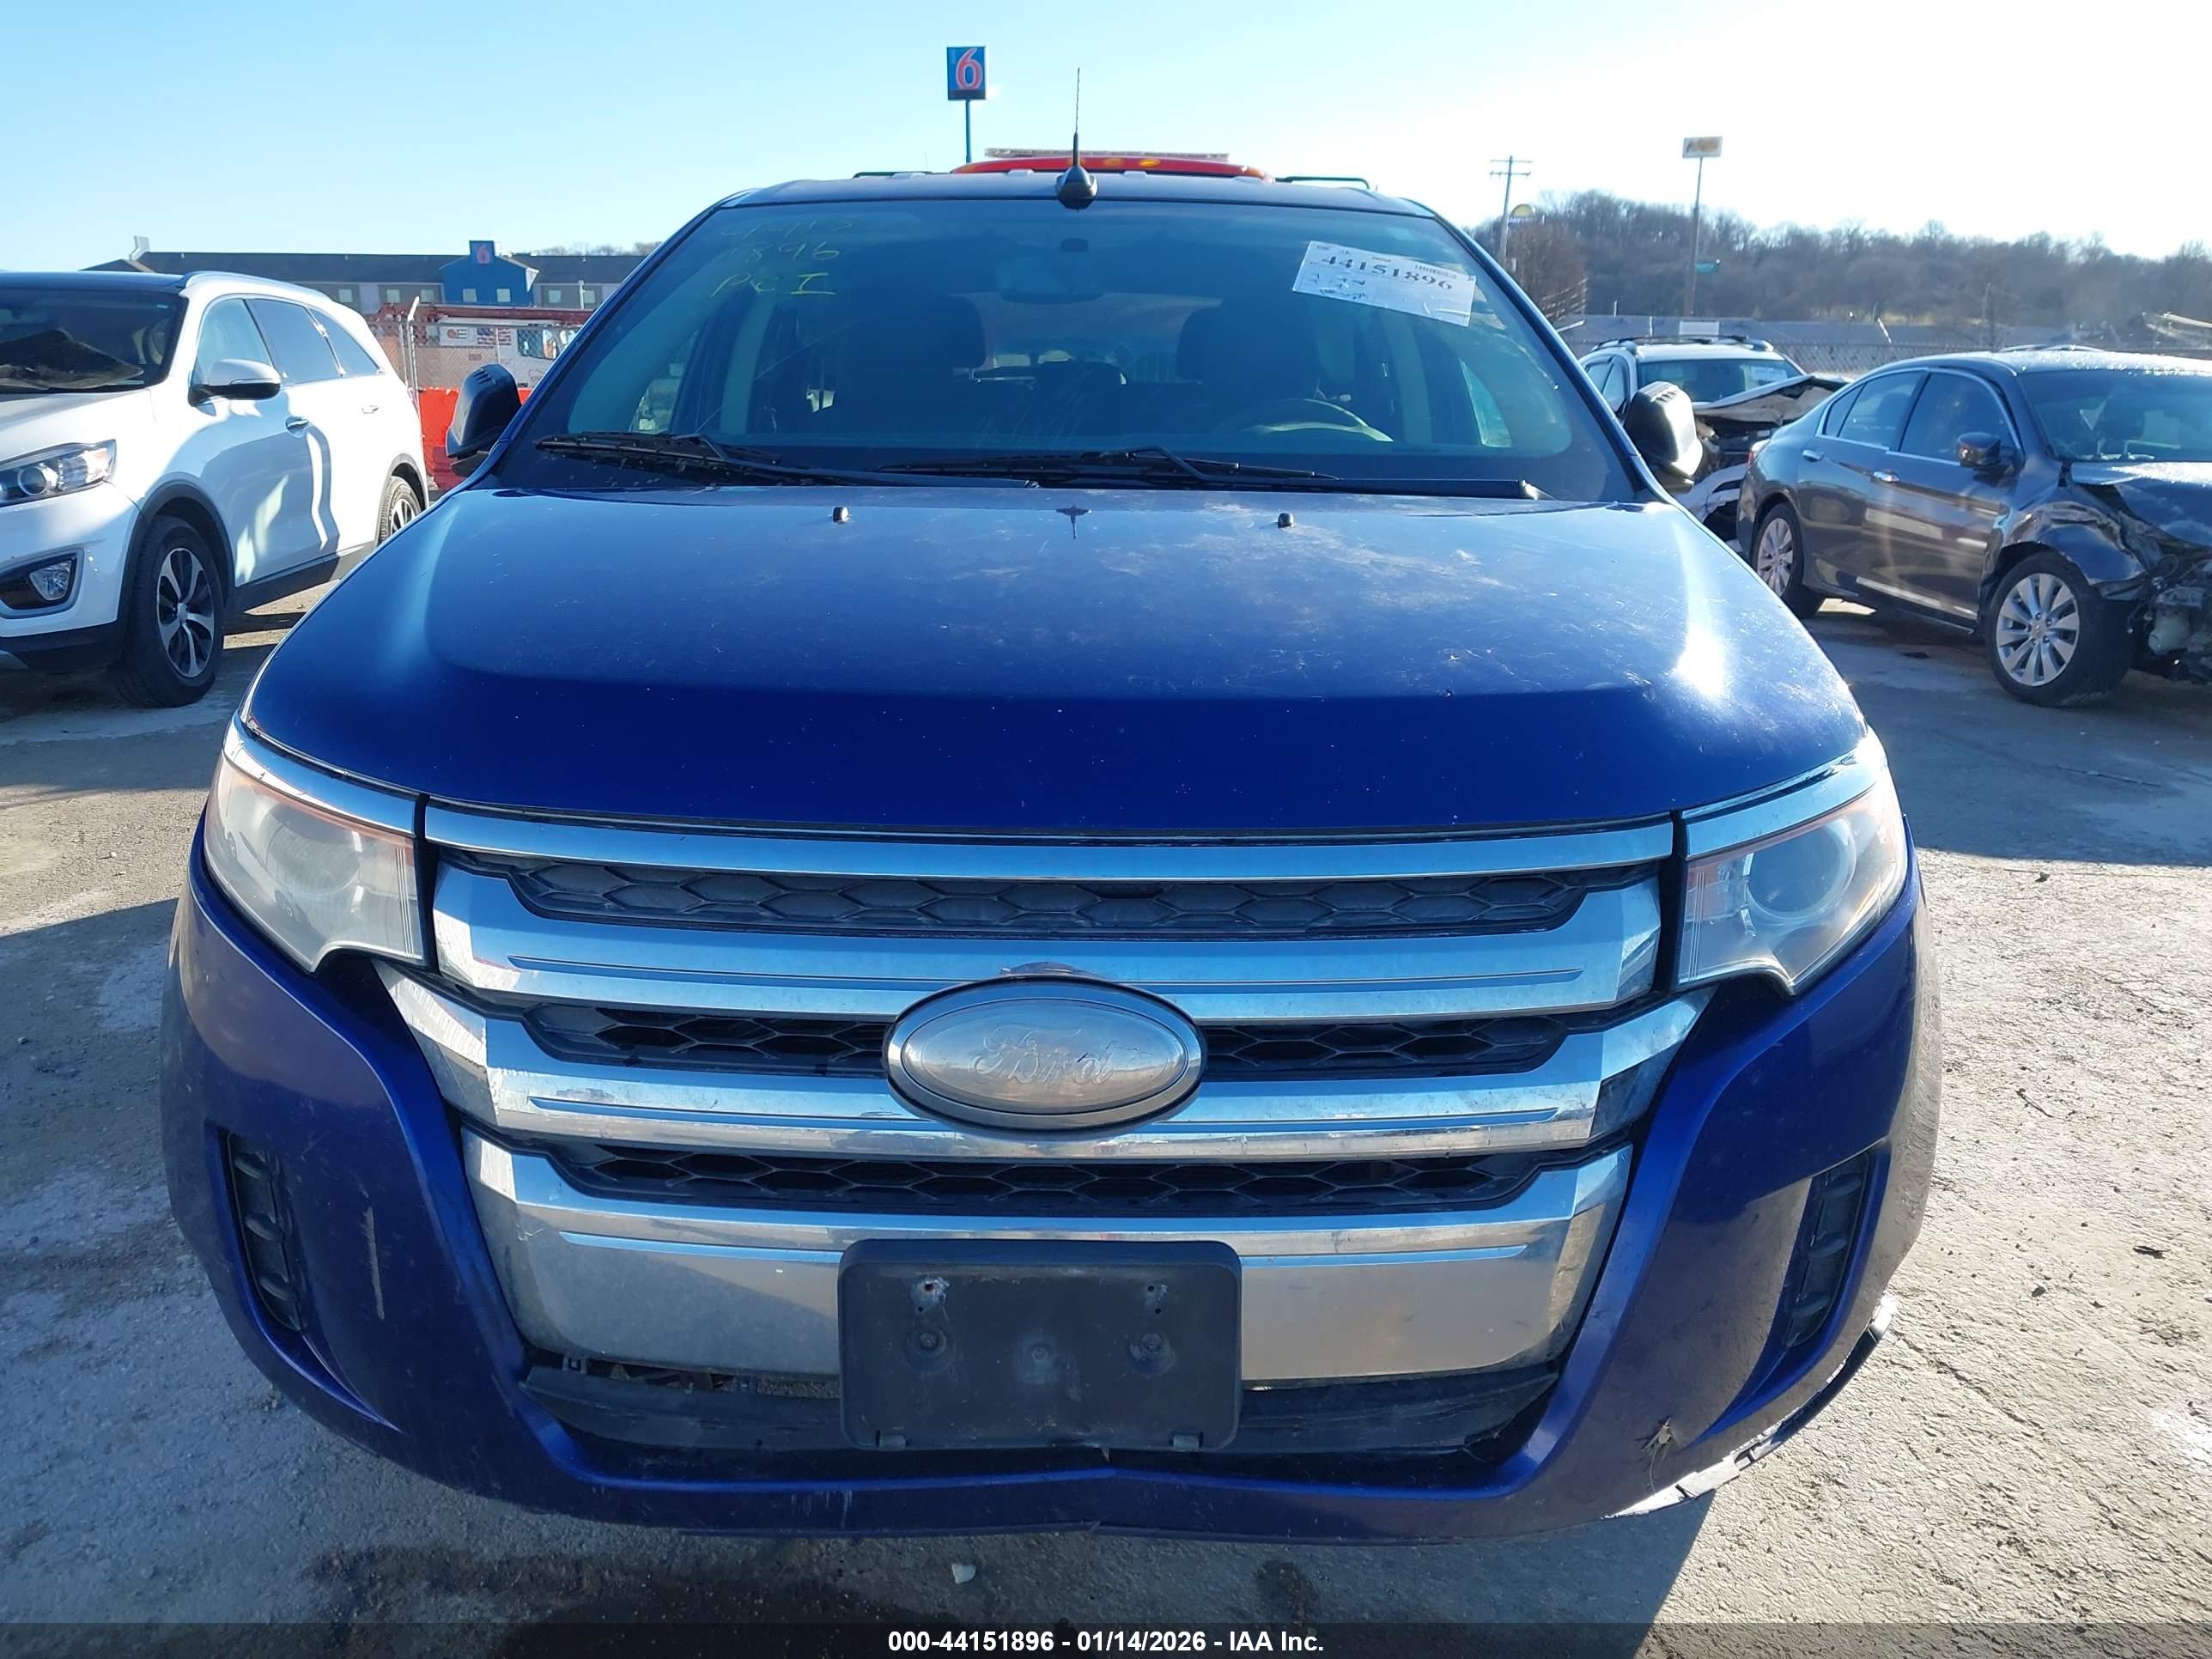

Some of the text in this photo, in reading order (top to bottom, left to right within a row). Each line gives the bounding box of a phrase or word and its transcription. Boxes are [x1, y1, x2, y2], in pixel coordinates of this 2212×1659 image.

[955, 47, 983, 90] 6
[477, 245, 491, 264] 6
[1322, 256, 1453, 290] 44151896
[968, 1022, 1116, 1085] Ford
